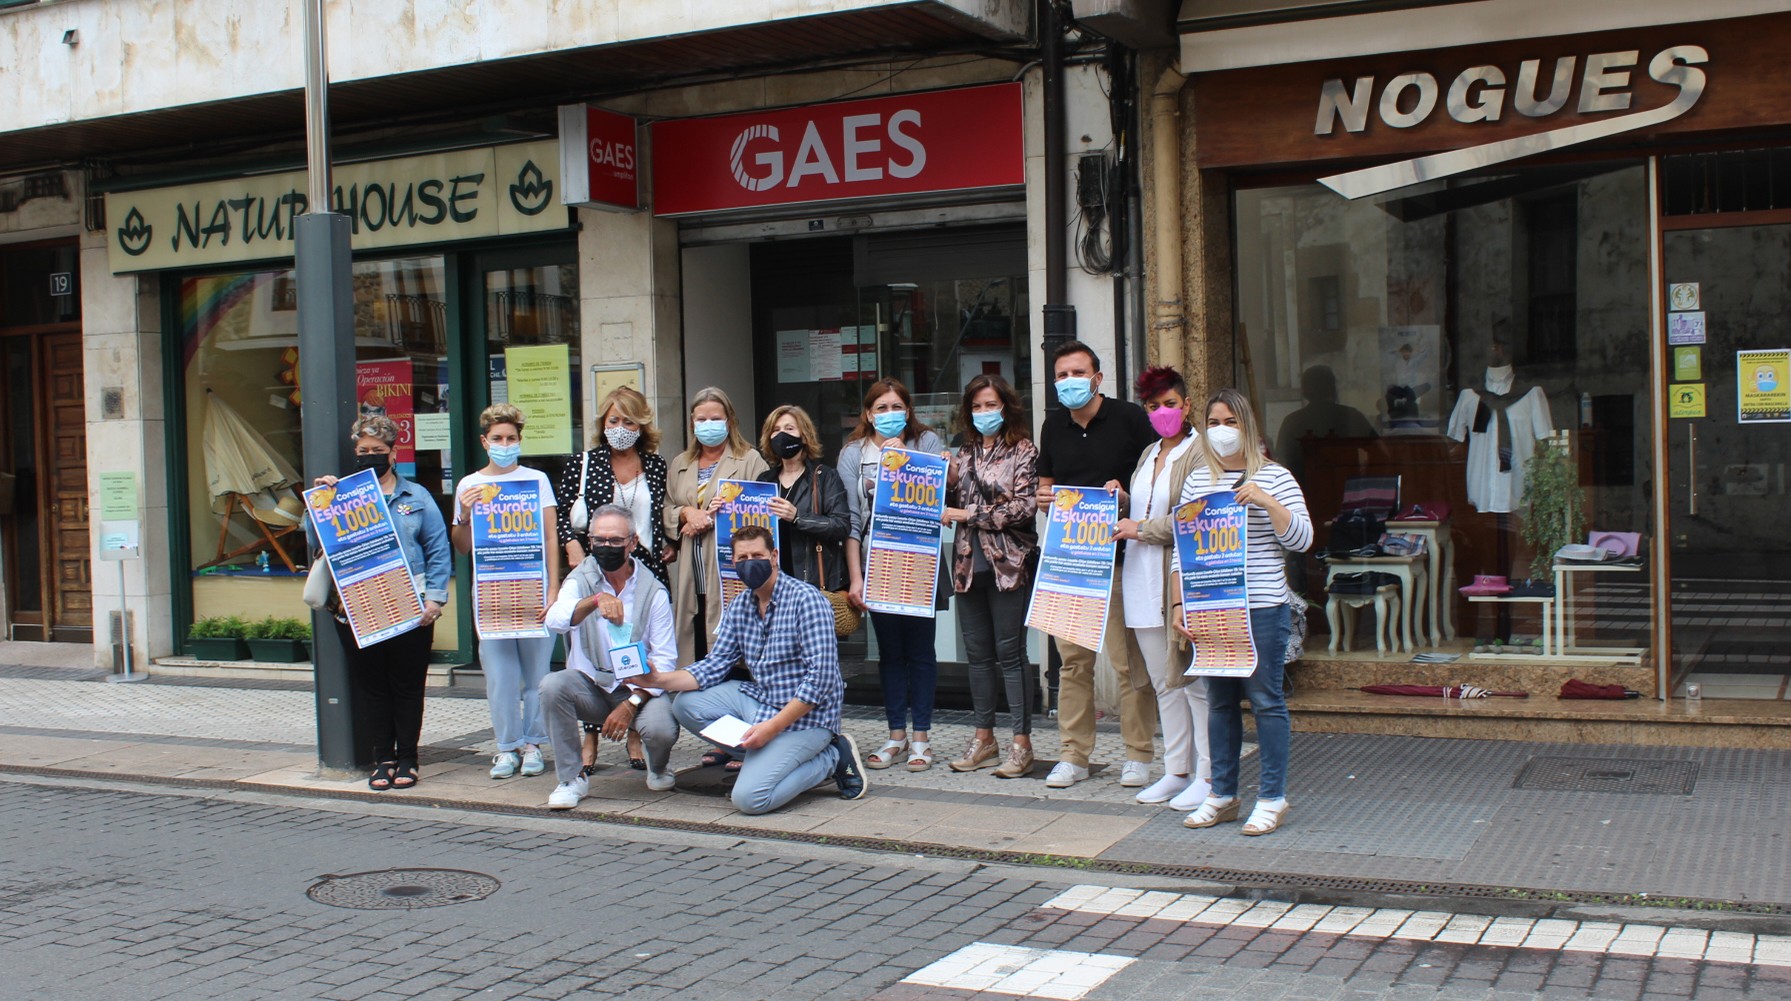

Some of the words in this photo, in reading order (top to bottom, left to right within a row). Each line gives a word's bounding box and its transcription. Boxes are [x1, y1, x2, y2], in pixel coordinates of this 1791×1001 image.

[1314, 45, 1710, 140] NOGUES
[590, 138, 633, 170] GAES
[730, 109, 927, 192] GAES
[55, 276, 67, 292] 19
[358, 374, 395, 386] Operación
[377, 383, 411, 397] BIKINI
[881, 467, 942, 488] Eskuratu
[906, 464, 942, 475] Consigue
[336, 484, 375, 501] Consigue
[499, 493, 537, 502] Consigue
[740, 494, 772, 503] Consigu
[314, 492, 379, 523] Eskuratu
[475, 501, 537, 515] Eskuratu
[1079, 501, 1115, 512] Consigue
[1205, 505, 1243, 515] Consigue
[1053, 507, 1114, 525] Eskuratu
[1178, 515, 1244, 535] Eskuratu
